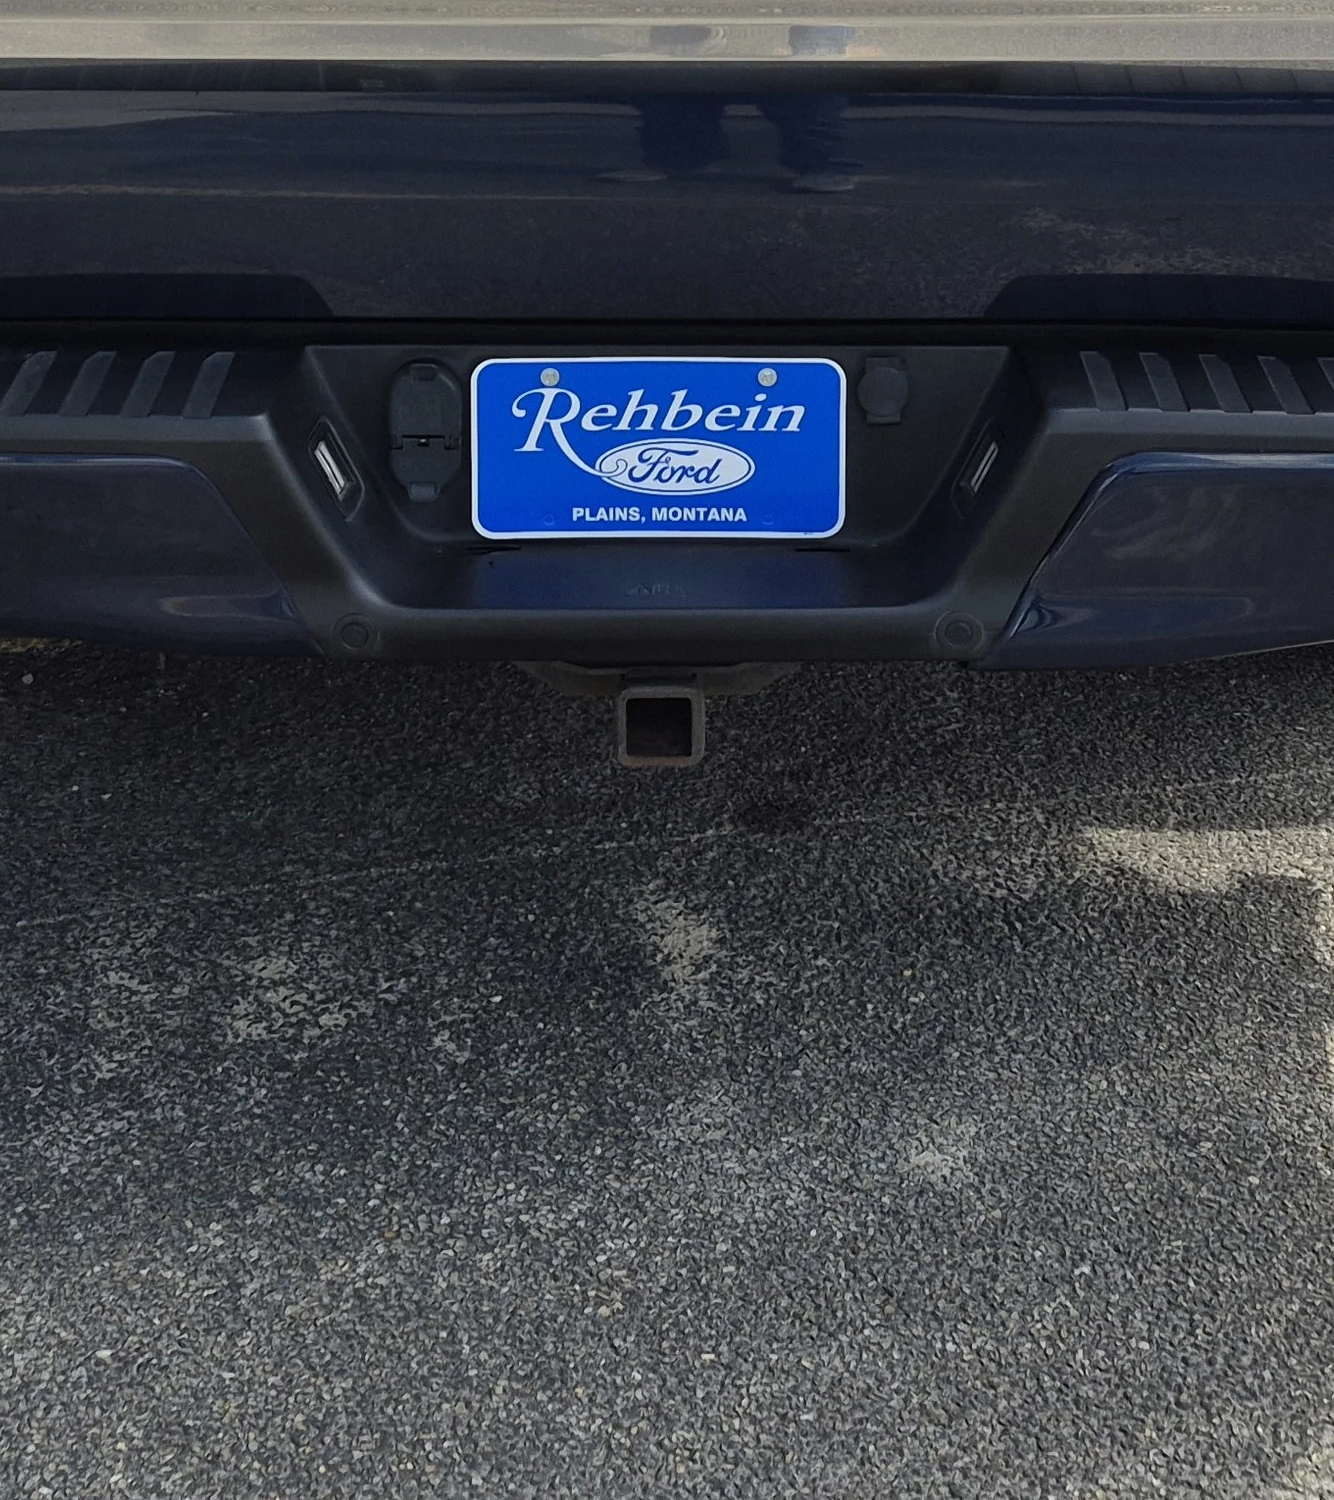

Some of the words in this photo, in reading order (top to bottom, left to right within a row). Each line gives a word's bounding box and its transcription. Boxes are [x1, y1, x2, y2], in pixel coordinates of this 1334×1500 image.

[511, 387, 806, 454] Rehbein
[627, 447, 723, 484] Ford
[572, 507, 646, 523] PLAINS,
[651, 507, 748, 522] MONTANA
